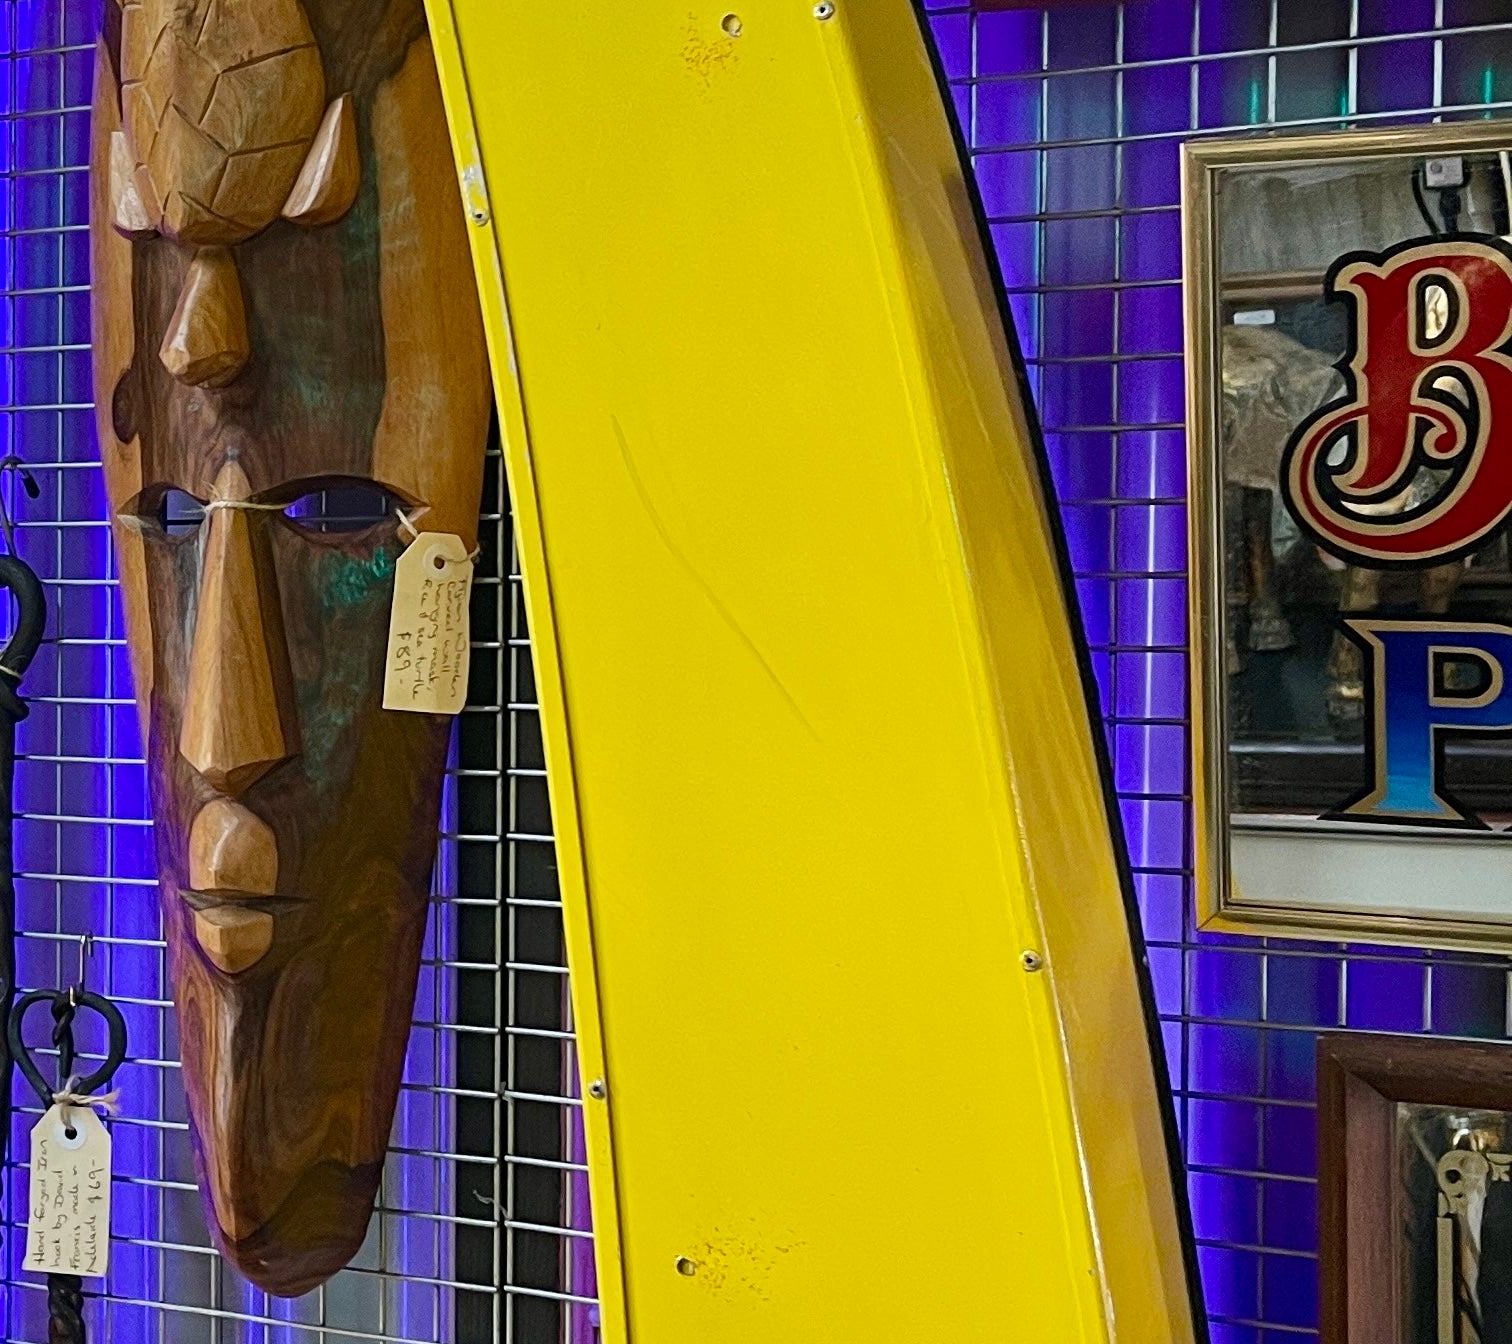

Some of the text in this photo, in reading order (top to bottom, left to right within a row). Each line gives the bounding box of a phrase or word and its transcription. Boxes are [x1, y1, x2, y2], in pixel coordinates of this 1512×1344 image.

[33, 1178, 49, 1222] forged
[51, 1214, 67, 1229] by
[32, 1231, 45, 1265] Hand
[49, 1237, 61, 1267] hook
